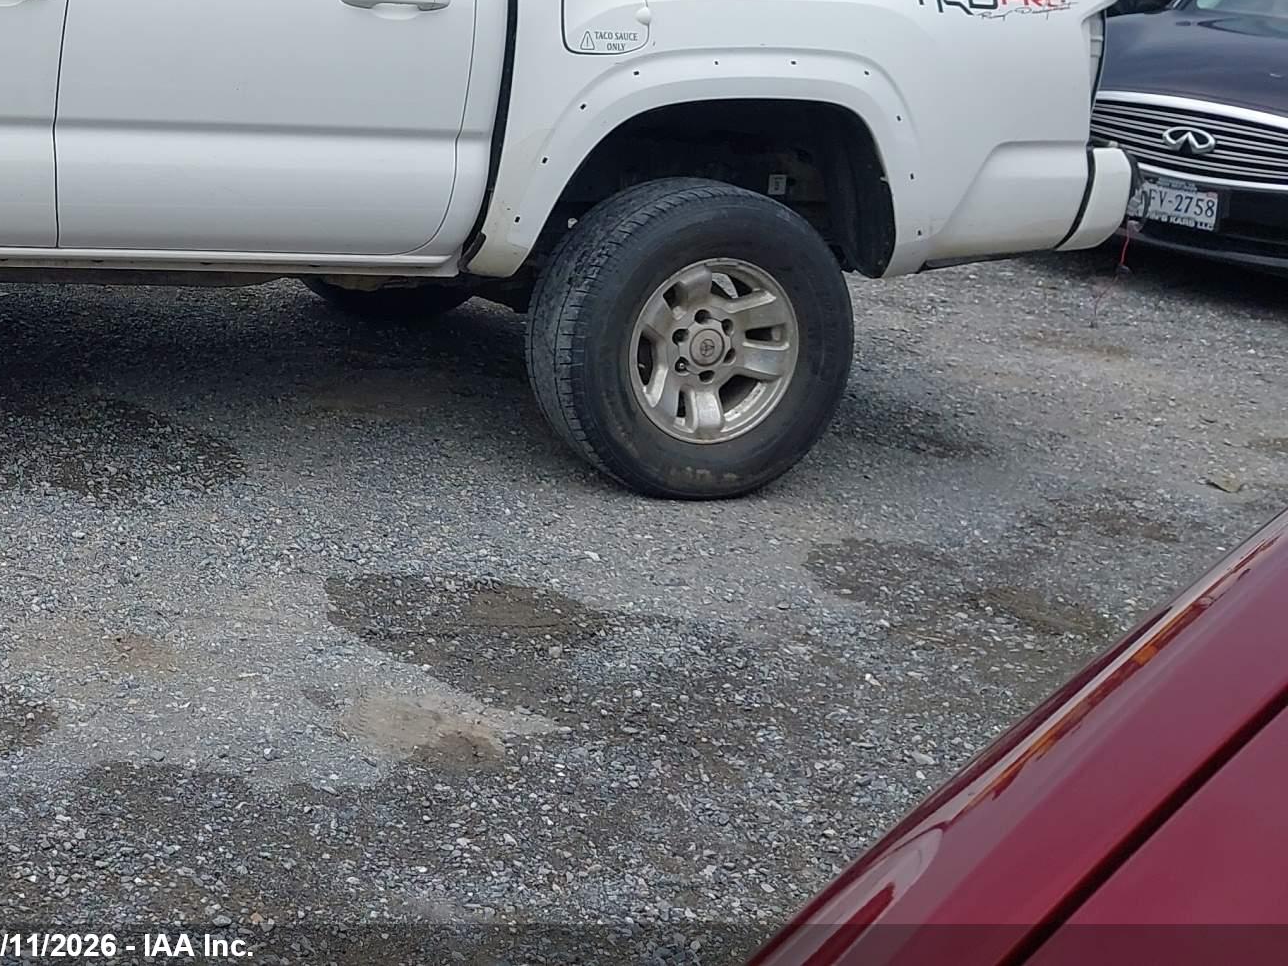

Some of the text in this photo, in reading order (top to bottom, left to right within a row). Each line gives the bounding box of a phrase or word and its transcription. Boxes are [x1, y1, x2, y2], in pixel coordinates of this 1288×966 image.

[594, 31, 638, 41] TACO SAUCE
[606, 43, 626, 51] ONLY
